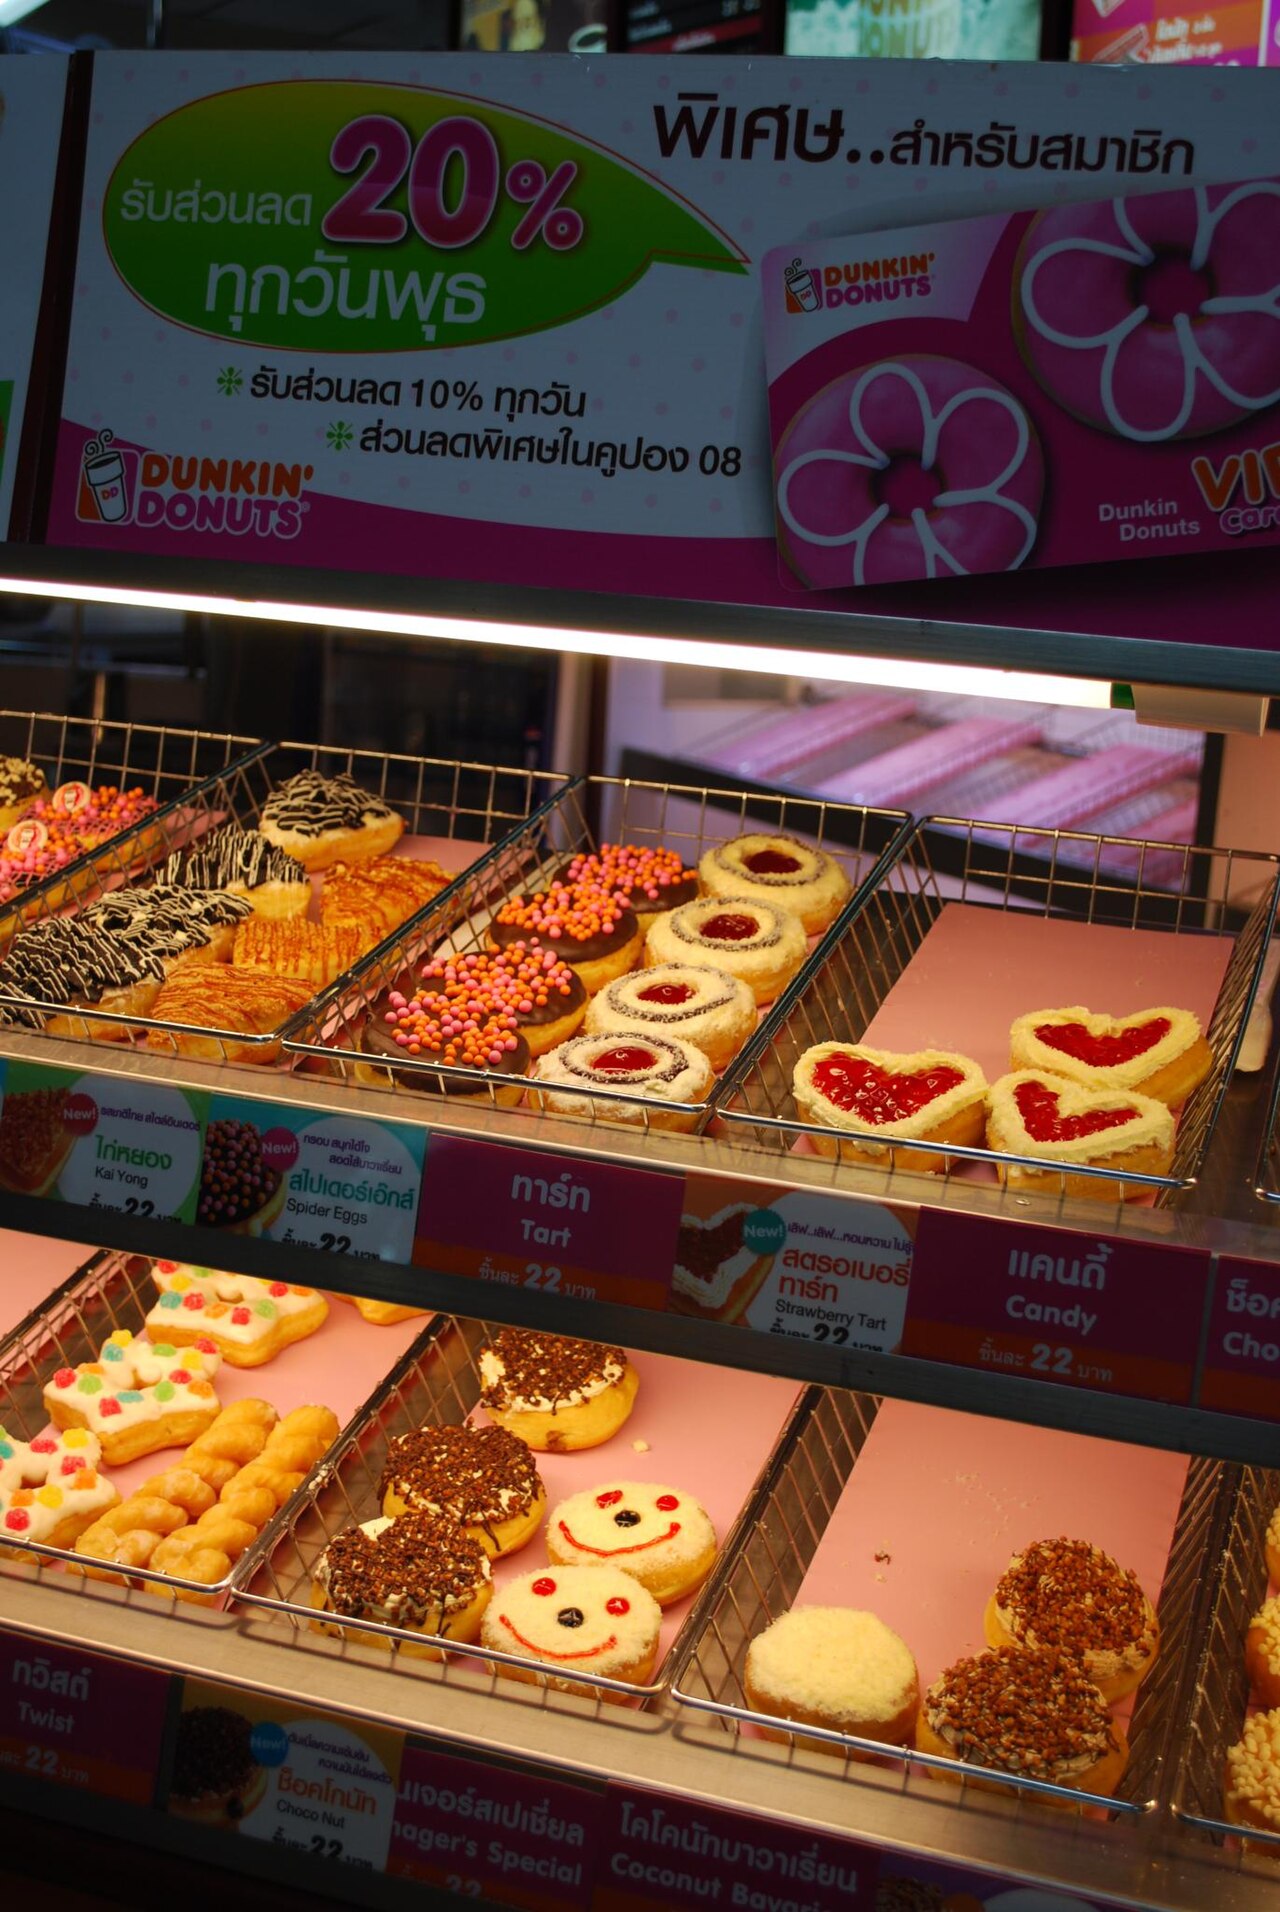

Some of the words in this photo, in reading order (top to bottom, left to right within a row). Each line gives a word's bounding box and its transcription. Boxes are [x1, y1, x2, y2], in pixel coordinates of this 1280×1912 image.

[119, 178, 313, 226] รับส่วนลด
[321, 114, 584, 249] 20%
[824, 253, 935, 287] DUNKIN'
[205, 249, 487, 342] ทุกวันพุธ
[826, 275, 931, 309] DONUTS
[250, 365, 402, 406] รับส่วนลด
[411, 379, 483, 411] 10%
[494, 382, 587, 421] ทุกวัน
[360, 419, 689, 477] ส่วนลดพิเศษในคูปอง
[699, 445, 742, 477] 08
[141, 453, 313, 498] DUNKIN'
[136, 490, 302, 539] DONUTS
[1098, 498, 1178, 522] Dunkin
[1219, 505, 1280, 536] Car
[1119, 518, 1201, 542] Donuts
[63, 1107, 97, 1120] New!
[95, 1134, 172, 1170] ไก่หยอง
[261, 1141, 297, 1154] New!
[95, 1165, 115, 1180] Kai
[117, 1169, 148, 1190] Yong
[125, 1197, 154, 1216] 22
[286, 1198, 331, 1216] Spider
[333, 1206, 368, 1226] Eggs
[320, 1232, 351, 1254] 22
[520, 1218, 572, 1248] Tart
[744, 1224, 784, 1238] New!
[478, 1256, 519, 1286] ชิ้นละ
[523, 1263, 562, 1293] 22
[564, 1282, 596, 1299] บาท
[1007, 1243, 1114, 1290] แคนดี้
[775, 1299, 854, 1327] Strawberry
[857, 1313, 887, 1331] Tart
[1005, 1294, 1098, 1336] Candy
[814, 1323, 849, 1344] 22
[979, 1337, 1025, 1367] ชิ้นละ
[1030, 1343, 1075, 1375] 22
[1076, 1361, 1112, 1382] บาท
[18, 1700, 75, 1734] Twist
[24, 1744, 59, 1775] 22
[277, 1799, 319, 1821] Choco
[322, 1811, 345, 1828] Nut
[486, 1840, 582, 1886] Special
[610, 1852, 723, 1899] Coconut
